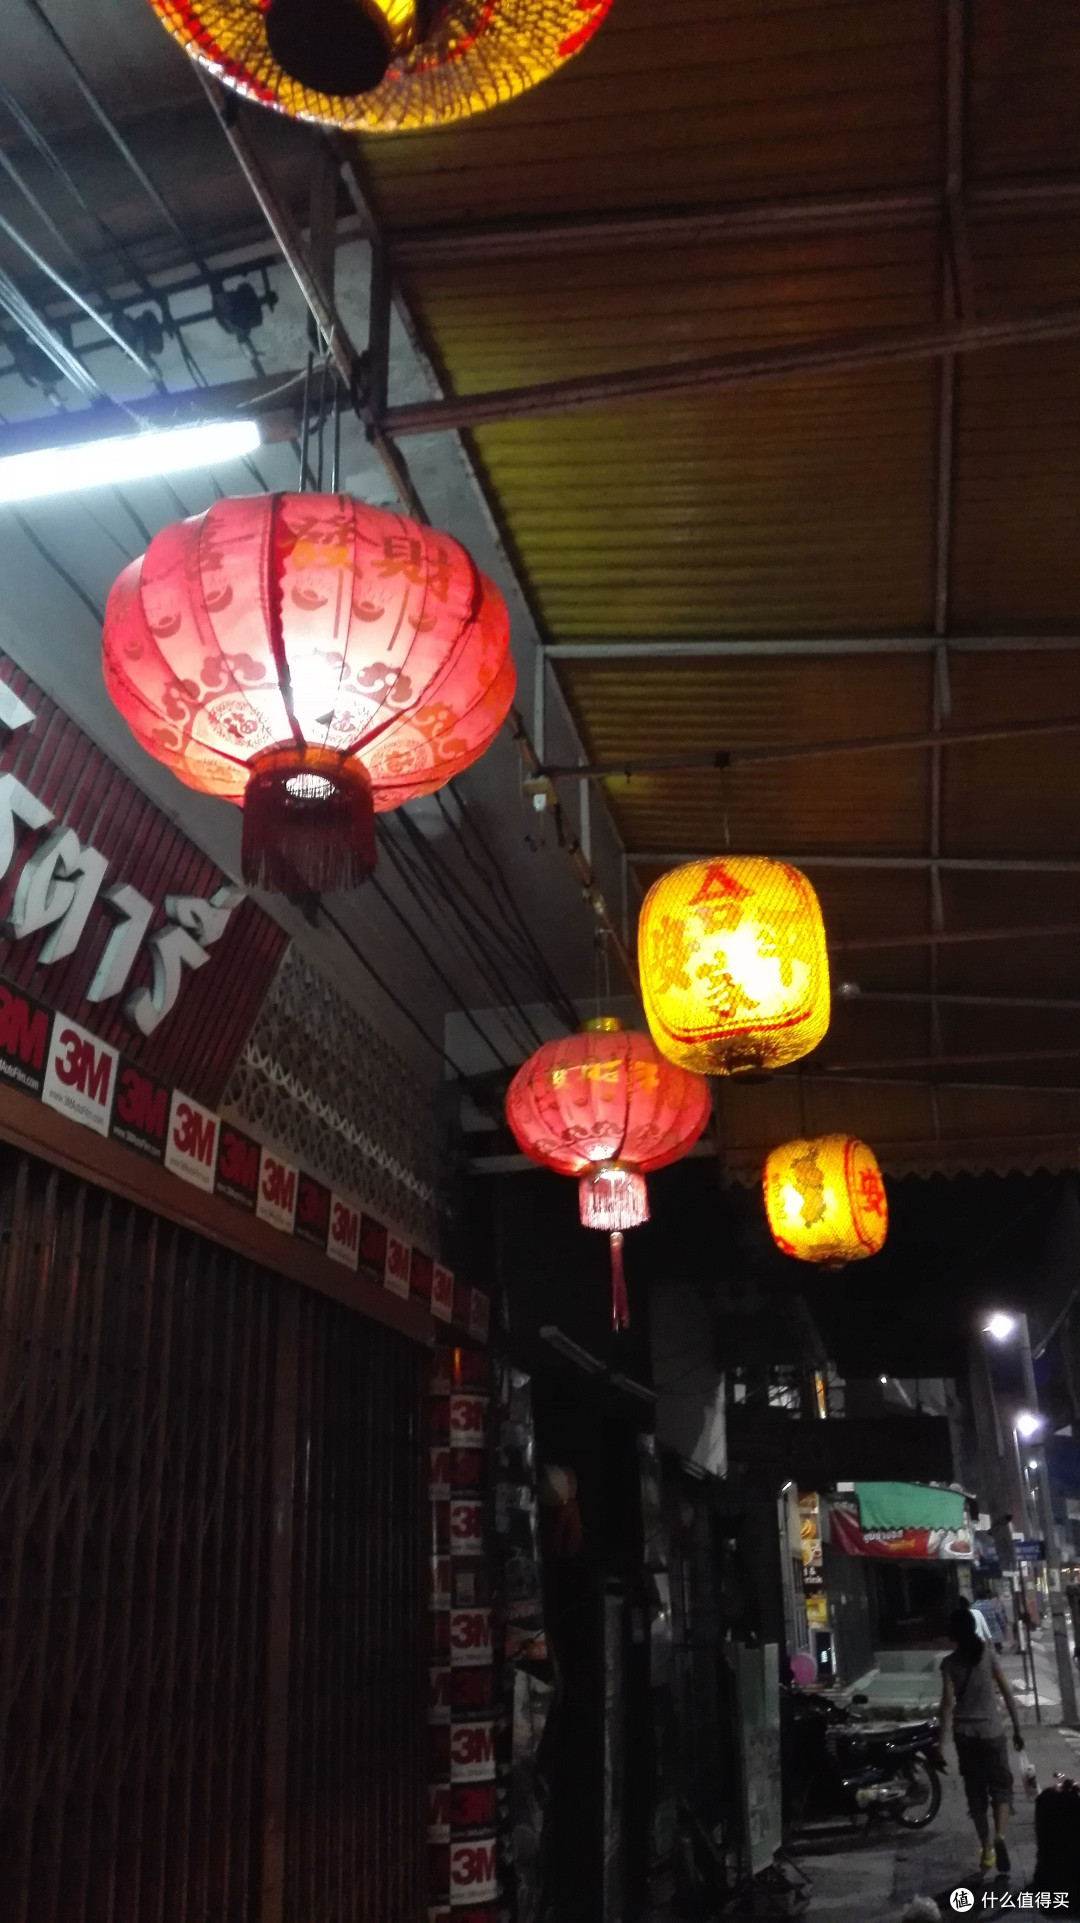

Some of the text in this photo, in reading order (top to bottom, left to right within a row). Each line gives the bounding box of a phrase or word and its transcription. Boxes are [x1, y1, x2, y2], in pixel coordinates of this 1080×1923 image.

[55, 1029, 112, 1107] 3M
[117, 1068, 167, 1139] 3M
[173, 1103, 216, 1167] 3M
[219, 1132, 257, 1191] 3M
[262, 1157, 295, 1213] 3M
[332, 1202, 358, 1251] 3M
[388, 1238, 410, 1282] 3M
[452, 1614, 490, 1648] 3M
[452, 1728, 495, 1764] 3M
[452, 1847, 497, 1884] 3M
